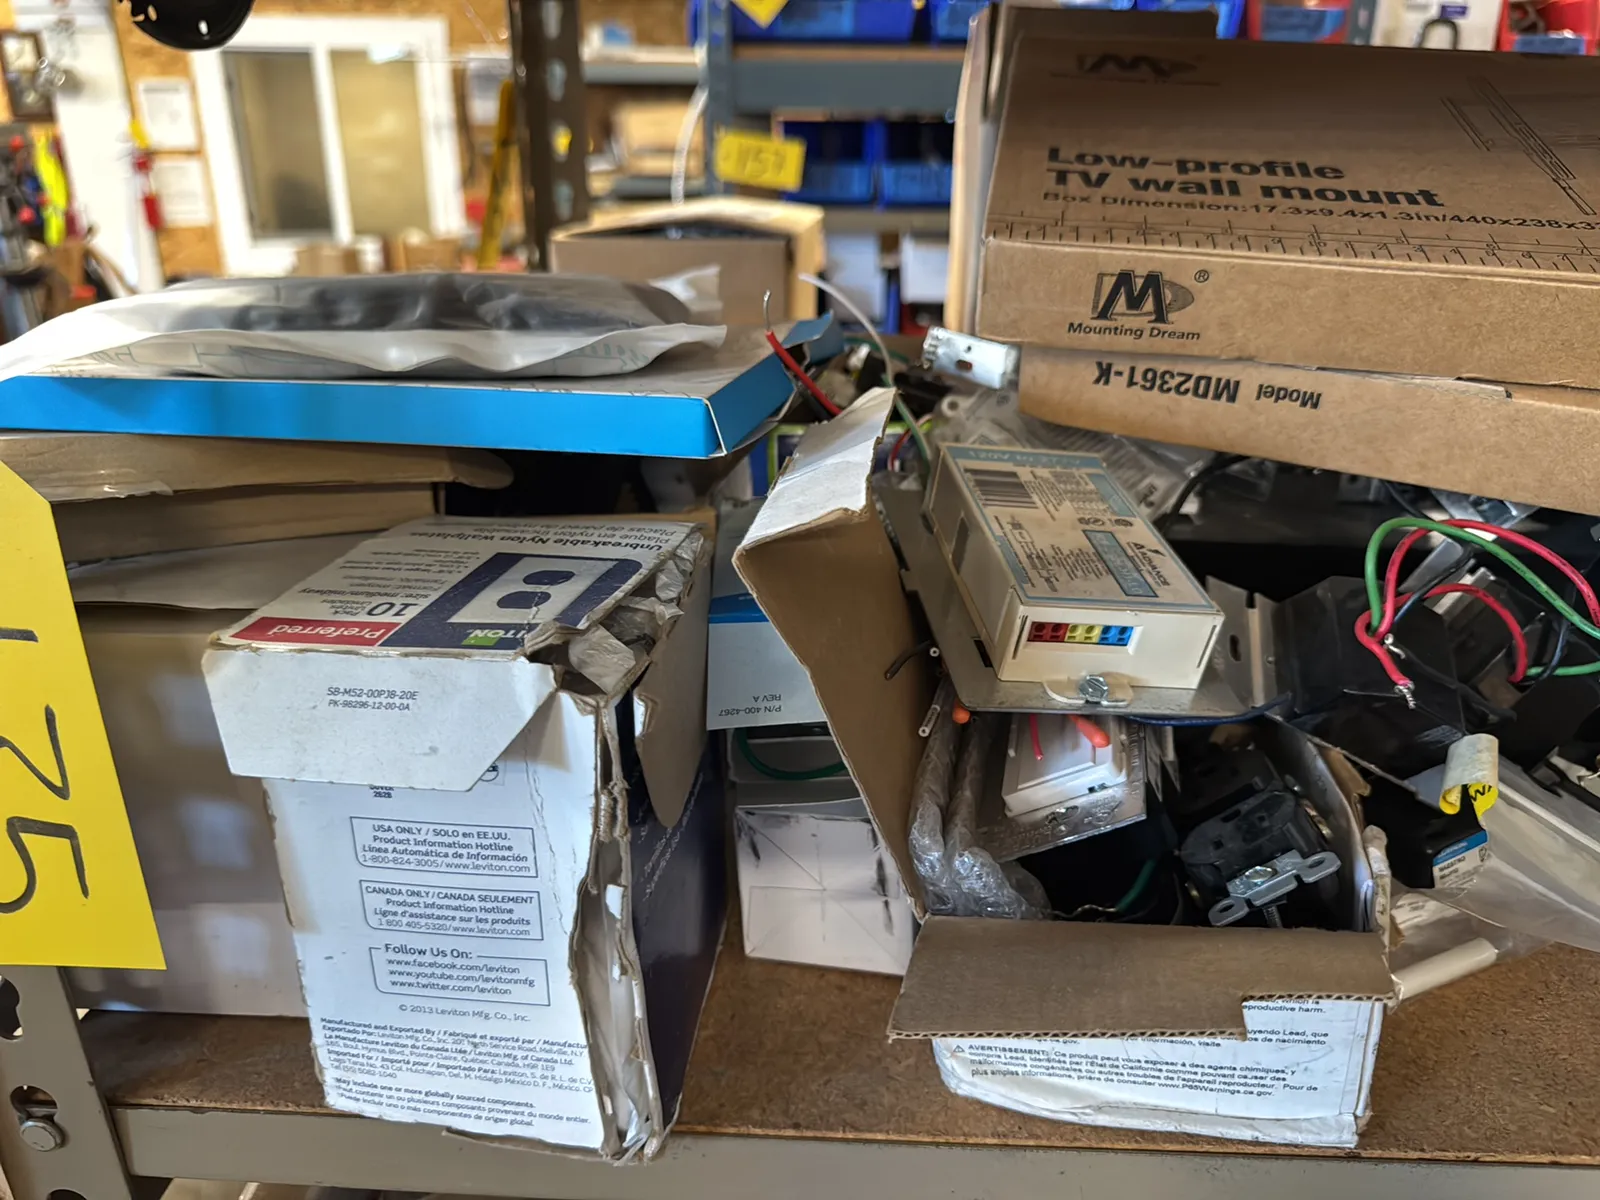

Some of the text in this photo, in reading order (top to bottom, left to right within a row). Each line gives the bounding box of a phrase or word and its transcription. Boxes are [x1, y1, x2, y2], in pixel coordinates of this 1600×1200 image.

[1047, 148, 1345, 180] Low-profile
[1047, 168, 1445, 208] TV wall mount
[1043, 192, 1091, 203] Box
[1066, 321, 1201, 342] Mounting Dream
[1091, 360, 1323, 410] Model MD2361-K
[553, 530, 595, 538] nylon
[618, 533, 671, 544] Plaque
[626, 525, 677, 537] Placas
[409, 532, 663, 551] Unbreakable Nylon Wallplates
[298, 587, 400, 599] medium/midway
[366, 601, 419, 617] 10
[266, 623, 387, 640] Preferred
[752, 693, 782, 703] REV A
[718, 704, 782, 717] P/N 400-4267
[372, 824, 392, 833] USA
[395, 825, 422, 835] ONLY
[432, 828, 460, 838] SOLO
[462, 831, 475, 839] en
[477, 831, 511, 841] EE.UU.
[373, 835, 514, 852] Product Information Hotline
[391, 846, 450, 859] Automática
[451, 851, 465, 860] de
[466, 851, 528, 863] Información
[365, 886, 404, 896] CANADA
[406, 888, 431, 898] ONLY
[437, 891, 475, 902] CANADA
[477, 894, 535, 905] SEULEMENT
[386, 898, 515, 915] Product Information Hotline
[374, 907, 531, 928] Ligne d'assistance sur les produits
[384, 943, 473, 959] Follow Us On:
[386, 958, 520, 974] www.facebook.com/leviton
[388, 968, 535, 987] www.youtube.com/levitonmfg
[389, 979, 512, 995] www.twitter.com/leviton
[410, 1004, 433, 1014] 2013
[435, 1006, 470, 1017] Leviton
[513, 1013, 531, 1022] Inc.
[1298, 1006, 1327, 1014] harm.
[320, 1017, 373, 1029] Manufactured
[389, 1025, 424, 1034] Exported
[443, 1030, 477, 1039] Fabriqué
[489, 1035, 521, 1043] exporté
[1283, 1029, 1309, 1038] Lead,
[1311, 1031, 1329, 1039] que
[1198, 1040, 1221, 1048] visite
[1275, 1037, 1327, 1046] nacimiento
[968, 1044, 1050, 1057] AVERTISSEMENT:
[1053, 1050, 1067, 1058] Ce
[1069, 1053, 1099, 1062] produit
[1100, 1055, 1120, 1063] peut
[1144, 1059, 1179, 1068] exposer
[1188, 1061, 1205, 1069] des
[1207, 1064, 1238, 1072] agents
[1239, 1065, 1290, 1076] chimiques,
[968, 1051, 1002, 1060] compris
[1069, 1060, 1084, 1068] par
[1121, 1063, 1164, 1074] Californie
[1164, 1068, 1199, 1077] comme
[1200, 1071, 1236, 1081] pouvant
[1237, 1073, 1269, 1081] causer
[971, 1067, 989, 1078] plus
[990, 1068, 1020, 1078] amples
[1077, 1073, 1102, 1082] prière
[1103, 1075, 1115, 1083] de
[1116, 1077, 1157, 1087] consulter
[1097, 1069, 1125, 1077] autres
[1126, 1071, 1162, 1081] troubles
[1176, 1075, 1217, 1087] l'appareil
[1282, 1083, 1305, 1091] Pour
[1306, 1084, 1319, 1092] de
[352, 1079, 379, 1090] include
[403, 1088, 423, 1096] more
[424, 1089, 456, 1100] globally
[456, 1094, 486, 1104] sourced
